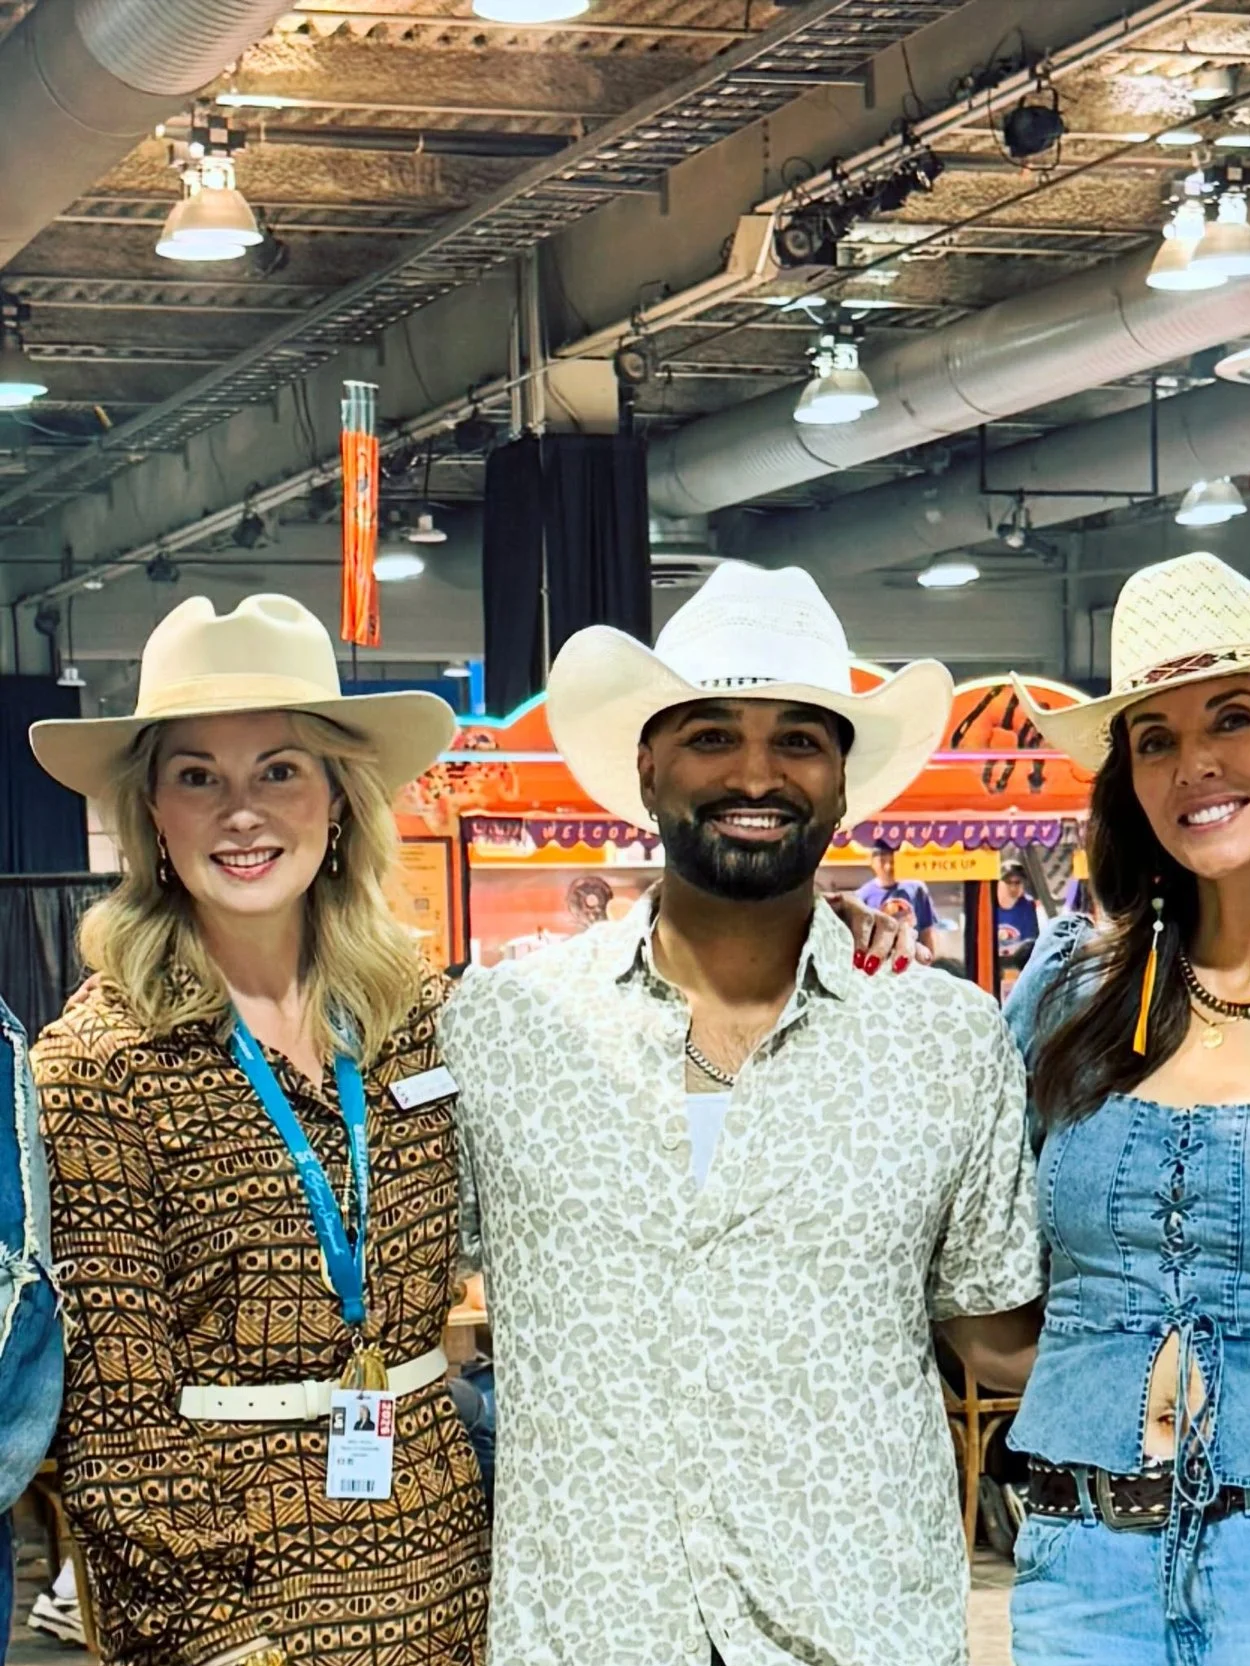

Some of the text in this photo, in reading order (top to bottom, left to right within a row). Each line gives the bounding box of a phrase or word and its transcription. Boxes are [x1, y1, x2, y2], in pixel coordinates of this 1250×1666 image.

[873, 825, 1052, 839] DONUT BAKERY
[932, 860, 957, 870] PICK
[961, 859, 976, 869] UP
